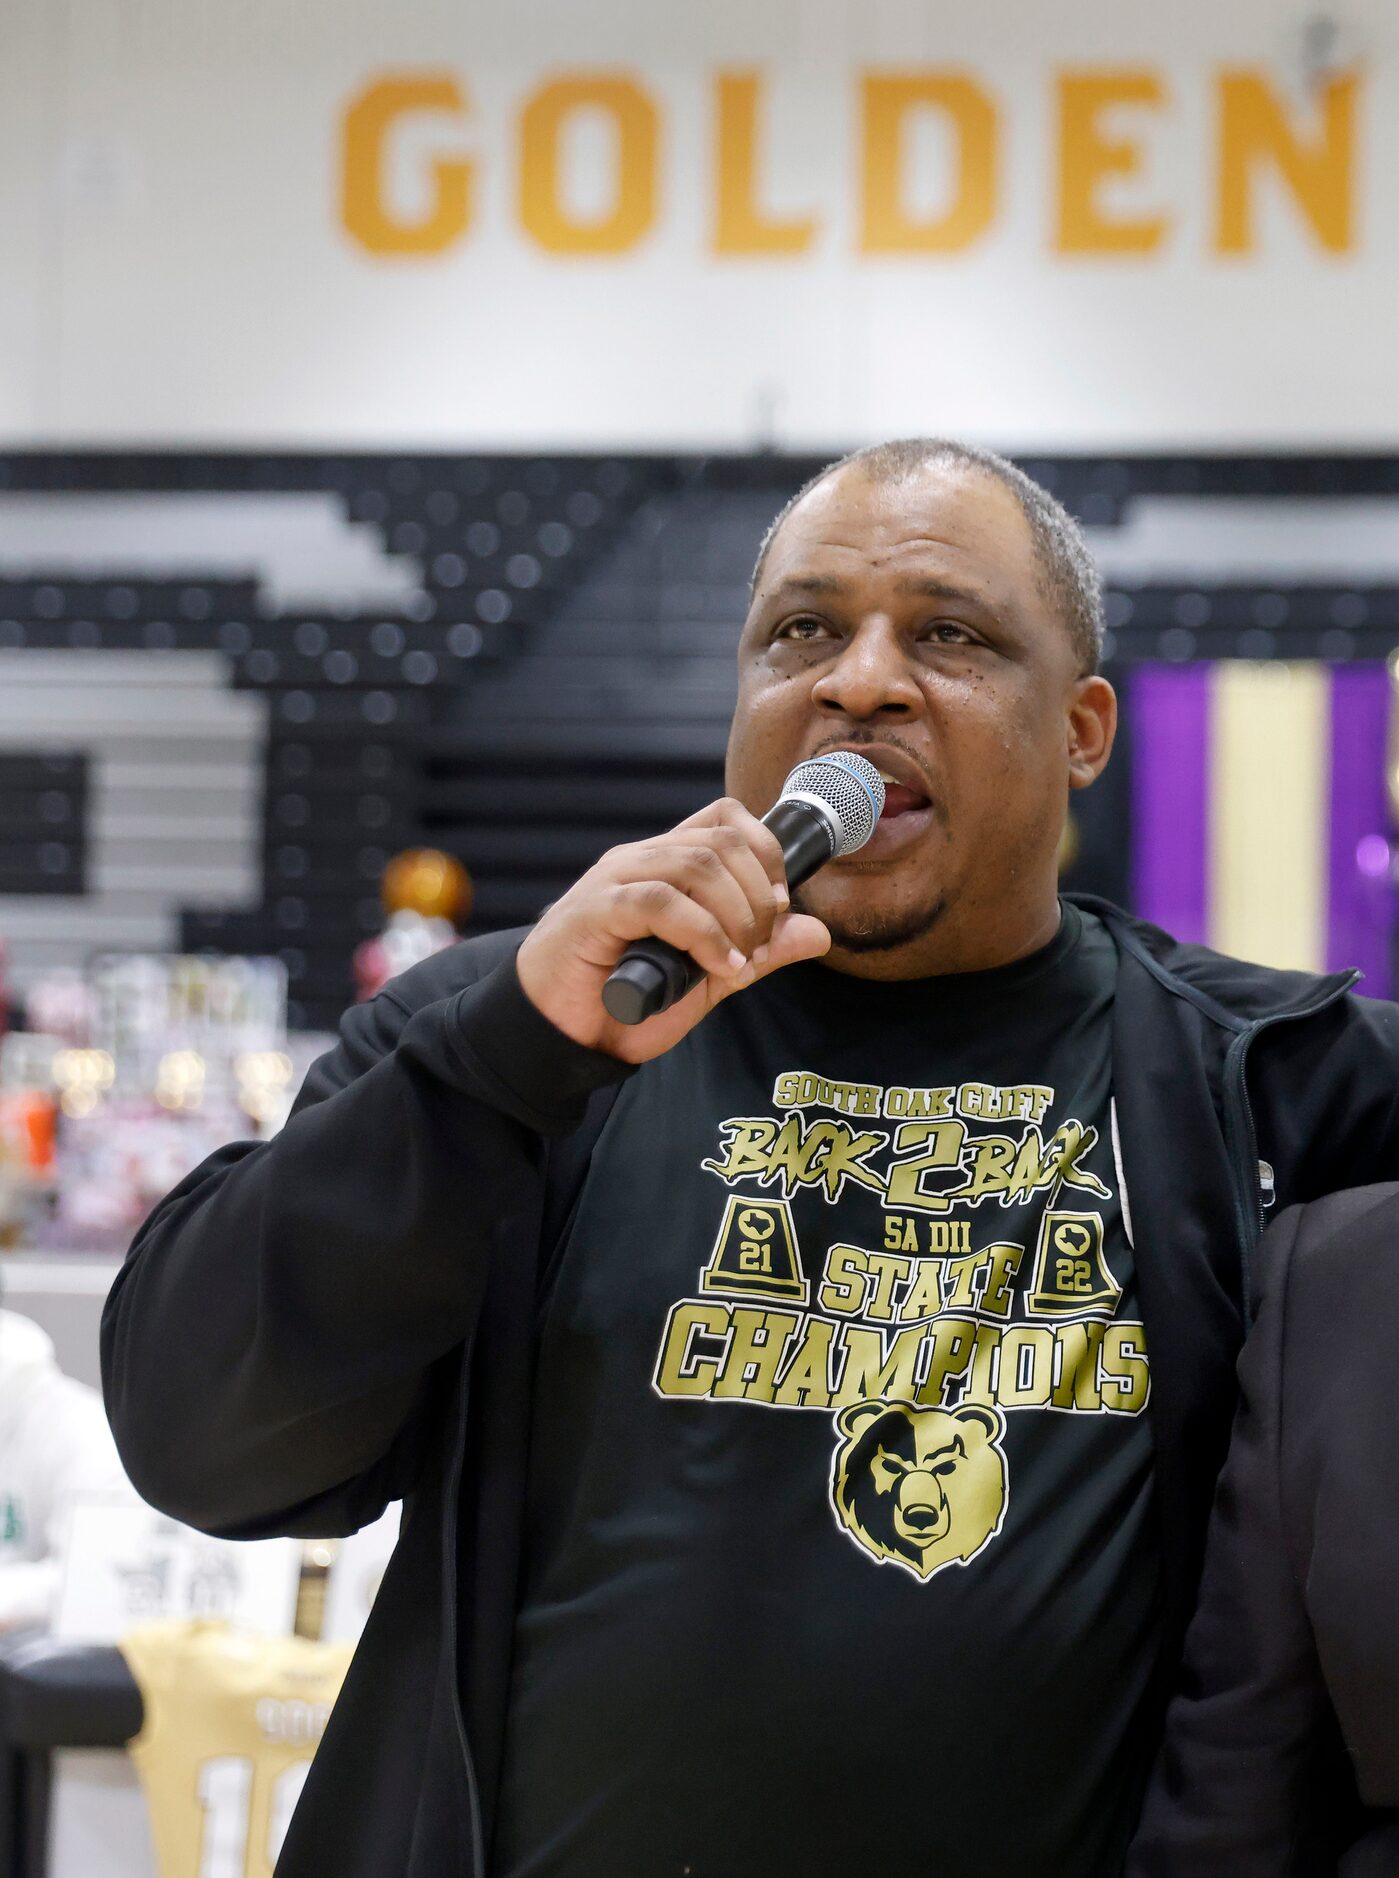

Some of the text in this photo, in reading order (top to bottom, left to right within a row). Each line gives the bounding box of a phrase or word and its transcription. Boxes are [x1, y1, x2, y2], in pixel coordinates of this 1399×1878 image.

[339, 66, 1364, 257] GOLDEN
[773, 1071, 1053, 1125] SOUTH OAK CLIFF
[703, 1111, 890, 1203] BACK
[883, 1119, 968, 1211] 2
[739, 1241, 773, 1272] 21
[929, 1221, 972, 1253] DII
[818, 1242, 1026, 1321] STATE
[1056, 1258, 1093, 1292] 22
[653, 1299, 1151, 1417] CHAMPIONS
